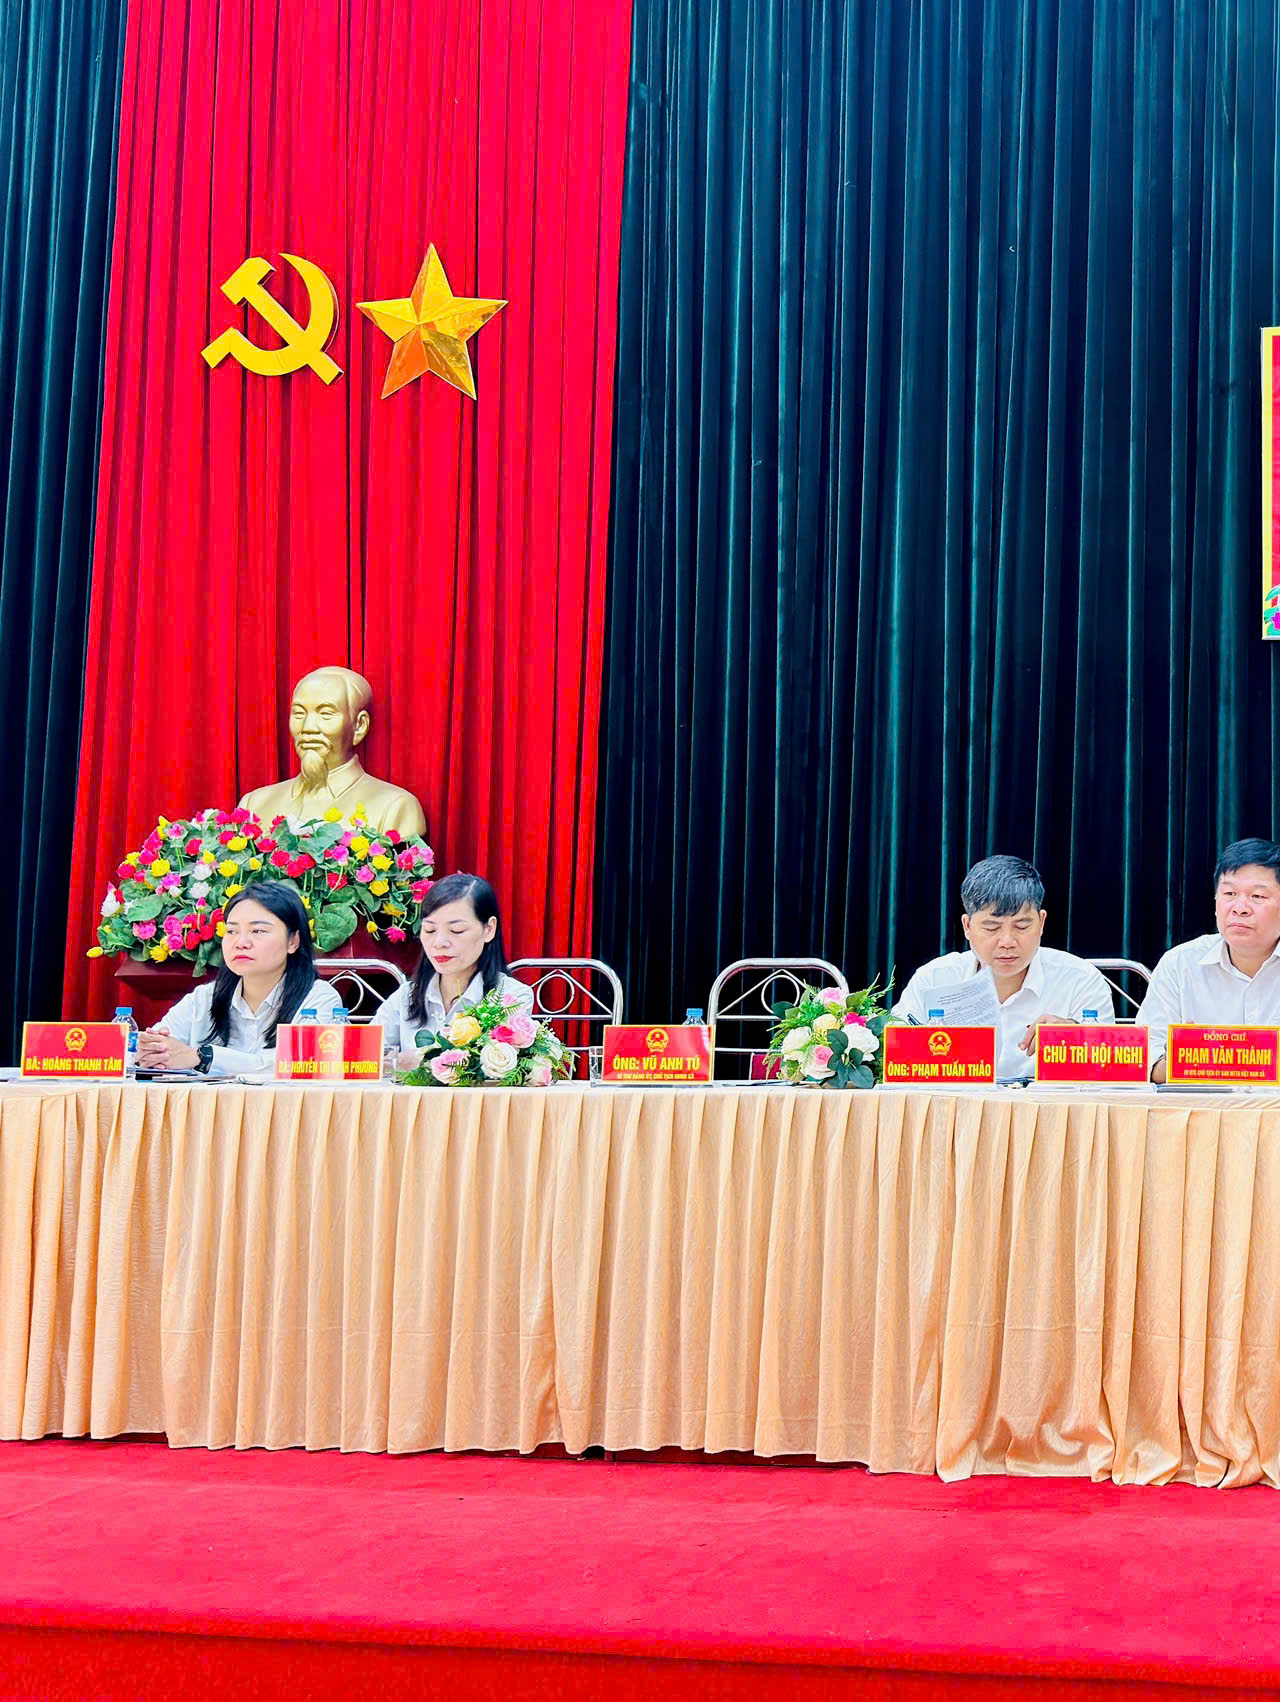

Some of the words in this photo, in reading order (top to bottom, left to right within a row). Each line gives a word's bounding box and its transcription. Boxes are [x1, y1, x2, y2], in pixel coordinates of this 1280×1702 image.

[1203, 1030, 1229, 1041] ĐỒNG
[1230, 1031, 1246, 1041] CHÍ
[613, 1054, 640, 1070] ÔNG:
[642, 1055, 657, 1070] VŨ
[660, 1057, 683, 1070] ANH
[686, 1054, 700, 1070] TÚ
[1043, 1039, 1067, 1064] CHỦ
[1069, 1041, 1088, 1064] TRÌ
[1091, 1042, 1112, 1068] HỘI
[1114, 1045, 1144, 1069] NGHỊ
[1178, 1047, 1210, 1067] PHẠM
[1211, 1044, 1234, 1065] VĂN
[1235, 1045, 1273, 1065] THÀNH
[26, 1056, 41, 1071] BÀ:
[42, 1056, 72, 1071] HOÀNG
[74, 1058, 102, 1071] THANH
[103, 1056, 123, 1071] TÂM
[887, 1060, 910, 1077] ÔNG:
[911, 1063, 939, 1079] PHẠM
[941, 1058, 966, 1077] TUẤN
[967, 1058, 992, 1077] THẢO
